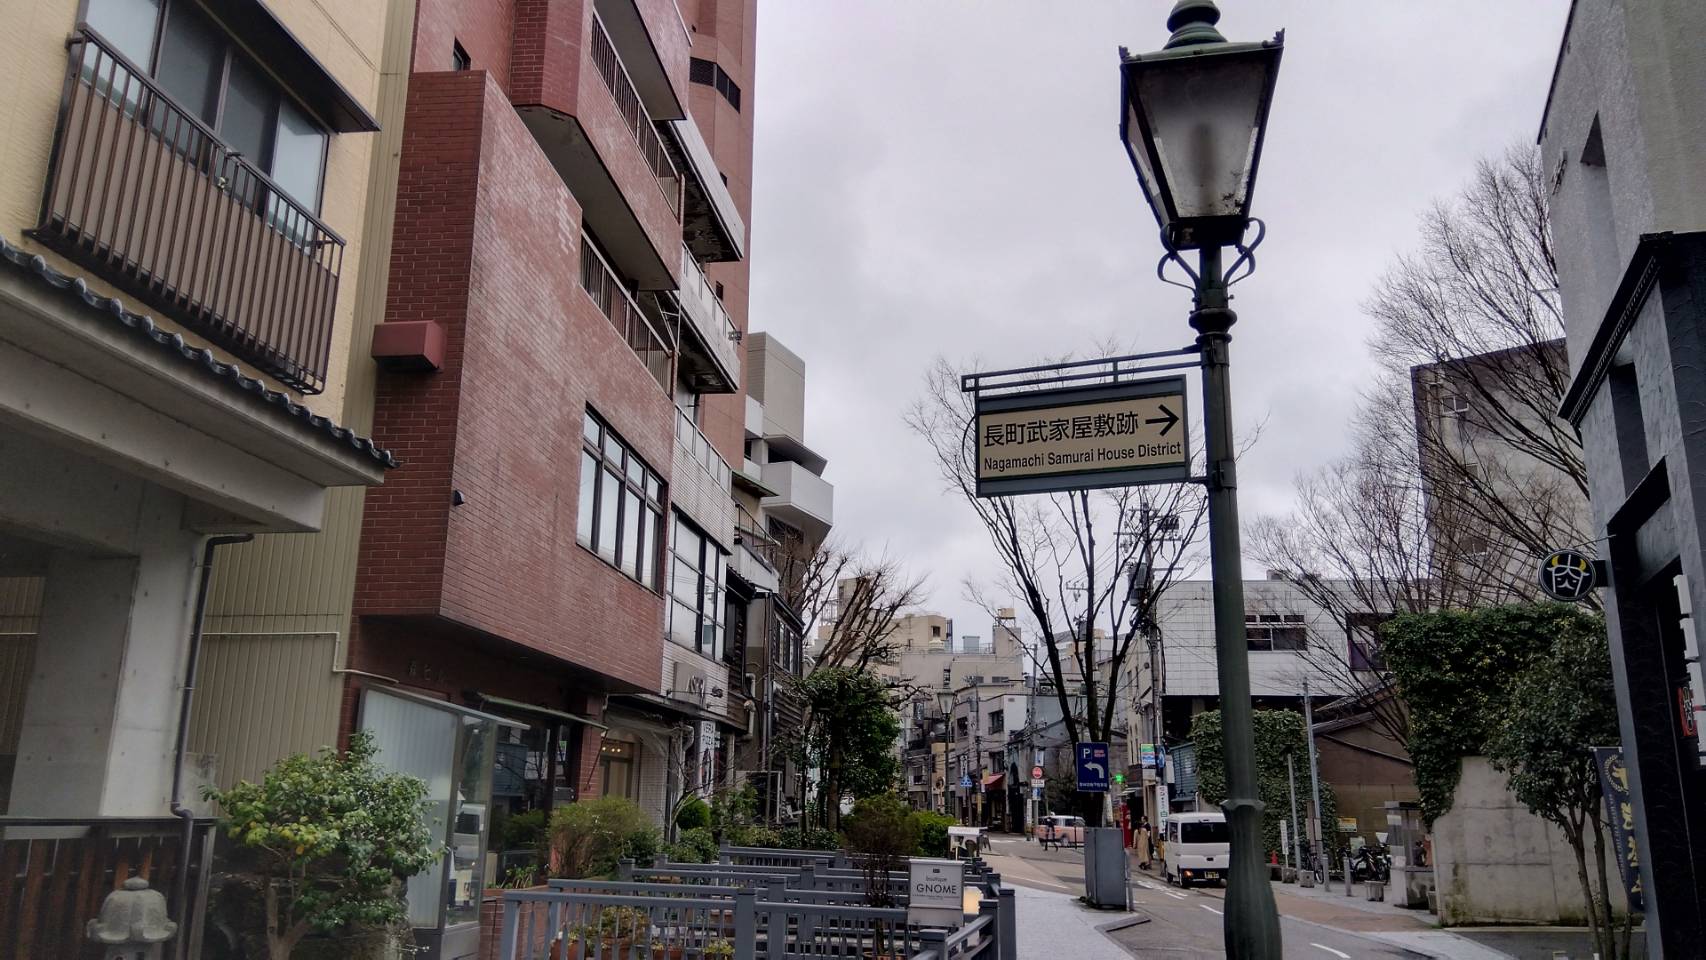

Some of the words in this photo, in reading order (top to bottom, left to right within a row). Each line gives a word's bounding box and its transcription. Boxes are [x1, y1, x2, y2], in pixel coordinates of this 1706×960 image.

[983, 411, 1139, 448] 長町武家屋敷跡
[984, 452, 1044, 472] Nagamachi
[1047, 449, 1094, 466] Samurai
[1097, 446, 1135, 461] House
[1138, 441, 1182, 458] District
[1083, 748, 1091, 759] P
[916, 883, 957, 895] GNOME
